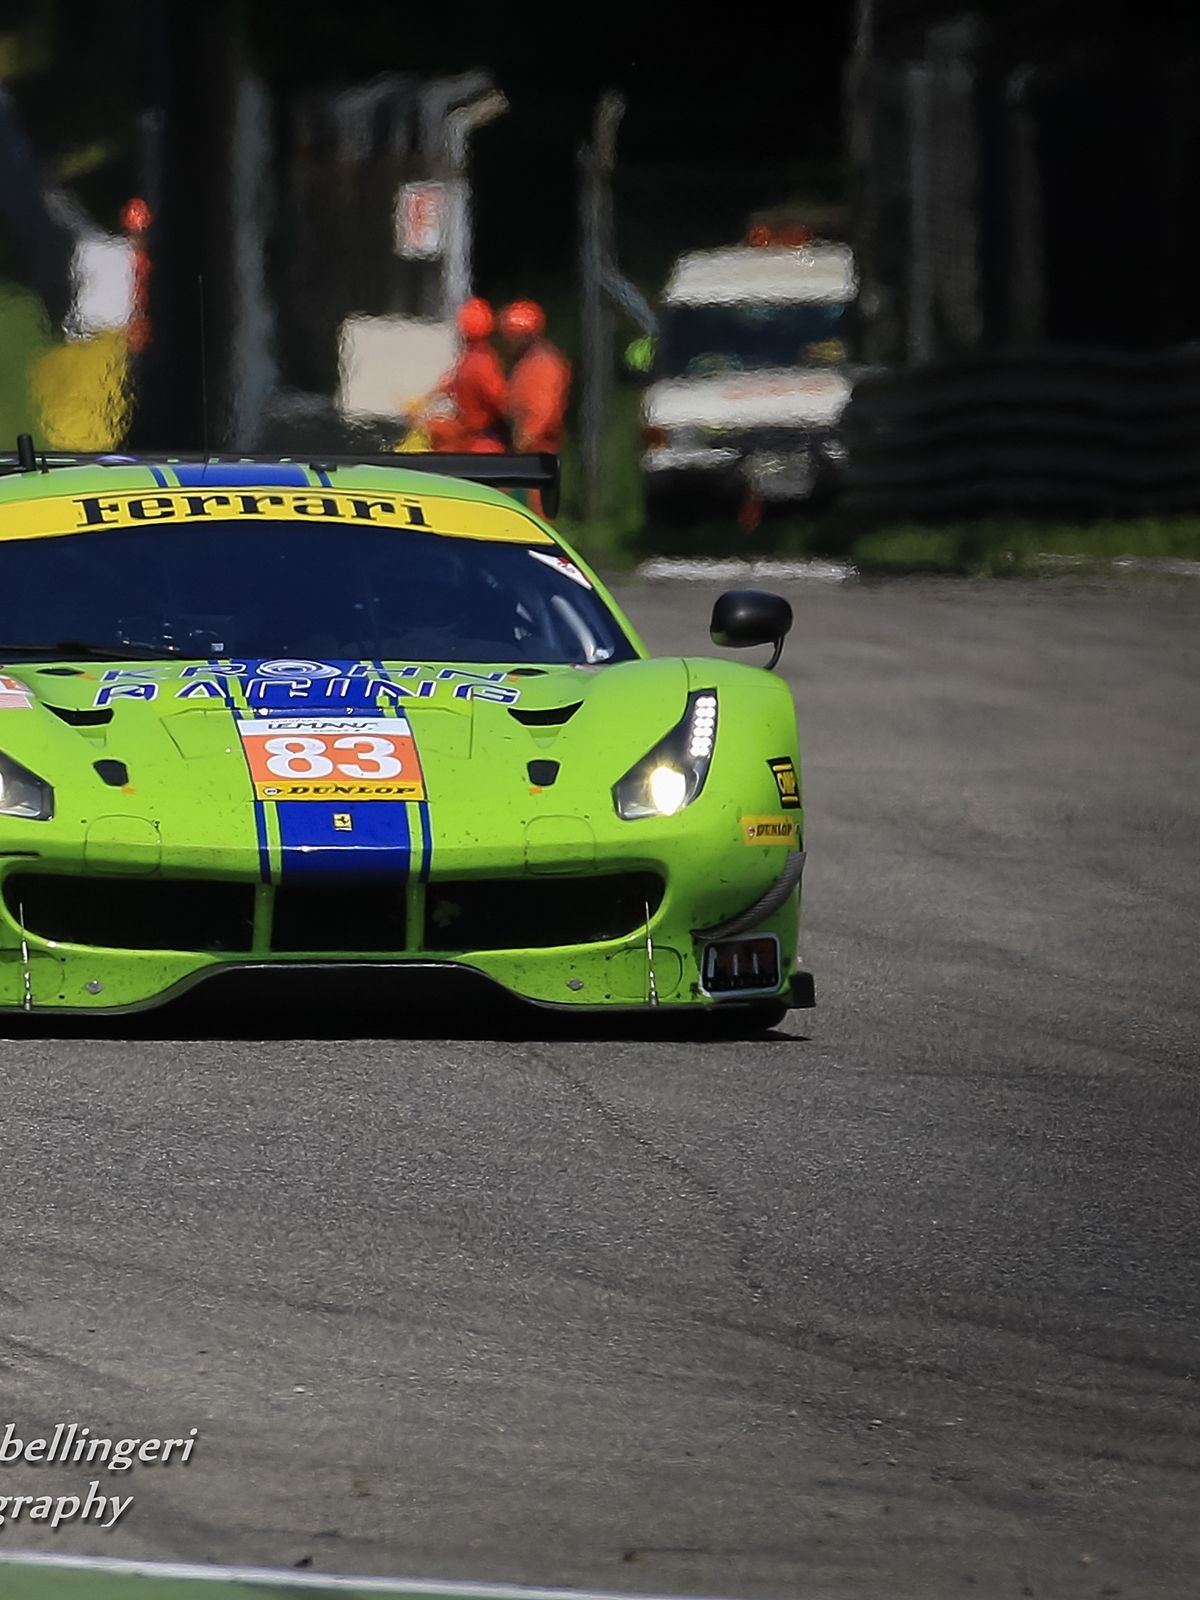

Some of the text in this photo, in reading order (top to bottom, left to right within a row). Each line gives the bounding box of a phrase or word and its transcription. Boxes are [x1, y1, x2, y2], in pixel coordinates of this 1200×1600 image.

[73, 495, 431, 528] Ferrari
[264, 736, 402, 780] 83
[287, 786, 416, 795] DUNLOP
